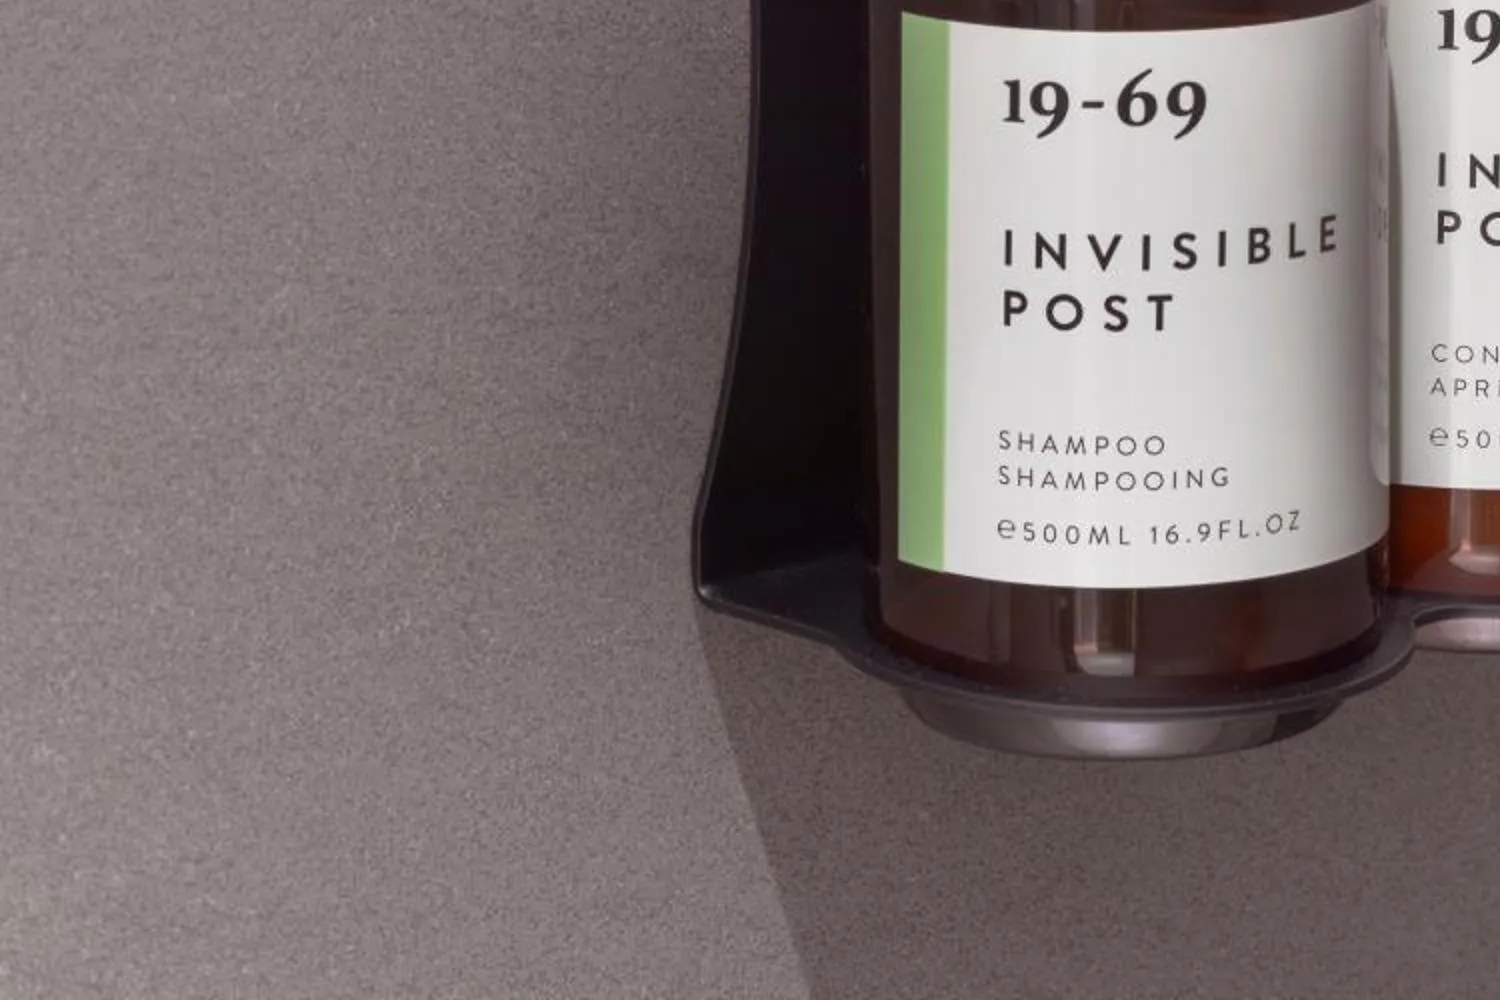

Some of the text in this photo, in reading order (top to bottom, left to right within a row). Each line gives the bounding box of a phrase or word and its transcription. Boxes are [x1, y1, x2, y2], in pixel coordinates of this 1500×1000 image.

[1003, 68, 1207, 141] 19-69
[1002, 214, 1337, 273] INVISIBLE
[1003, 289, 1174, 333] POST
[998, 429, 1166, 457] SHAMPOO
[998, 464, 1229, 493] SHAMPOOING
[1150, 509, 1300, 546] 16.9FL.OZ
